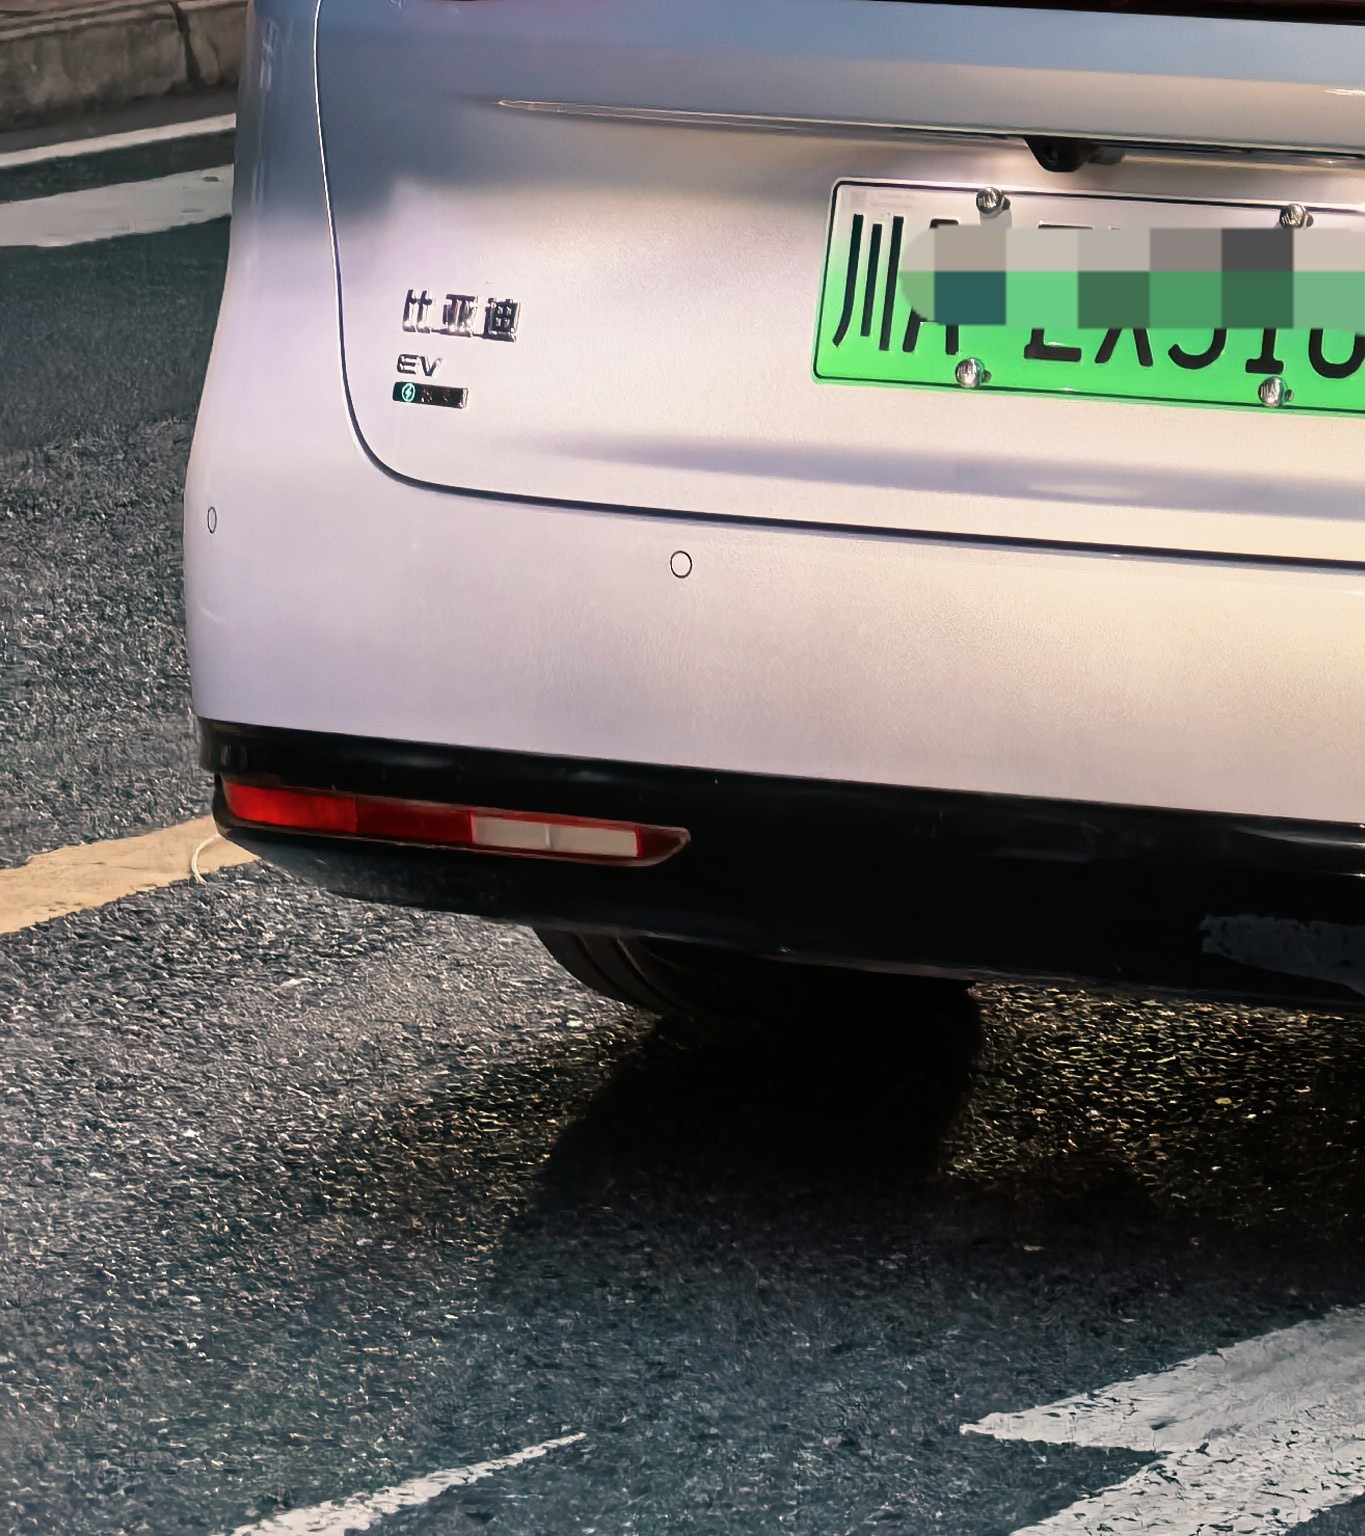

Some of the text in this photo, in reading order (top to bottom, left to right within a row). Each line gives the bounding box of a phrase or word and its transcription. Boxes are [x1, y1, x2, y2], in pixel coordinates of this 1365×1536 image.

[402, 289, 521, 342] 比亚迪
[397, 353, 442, 377] EV
